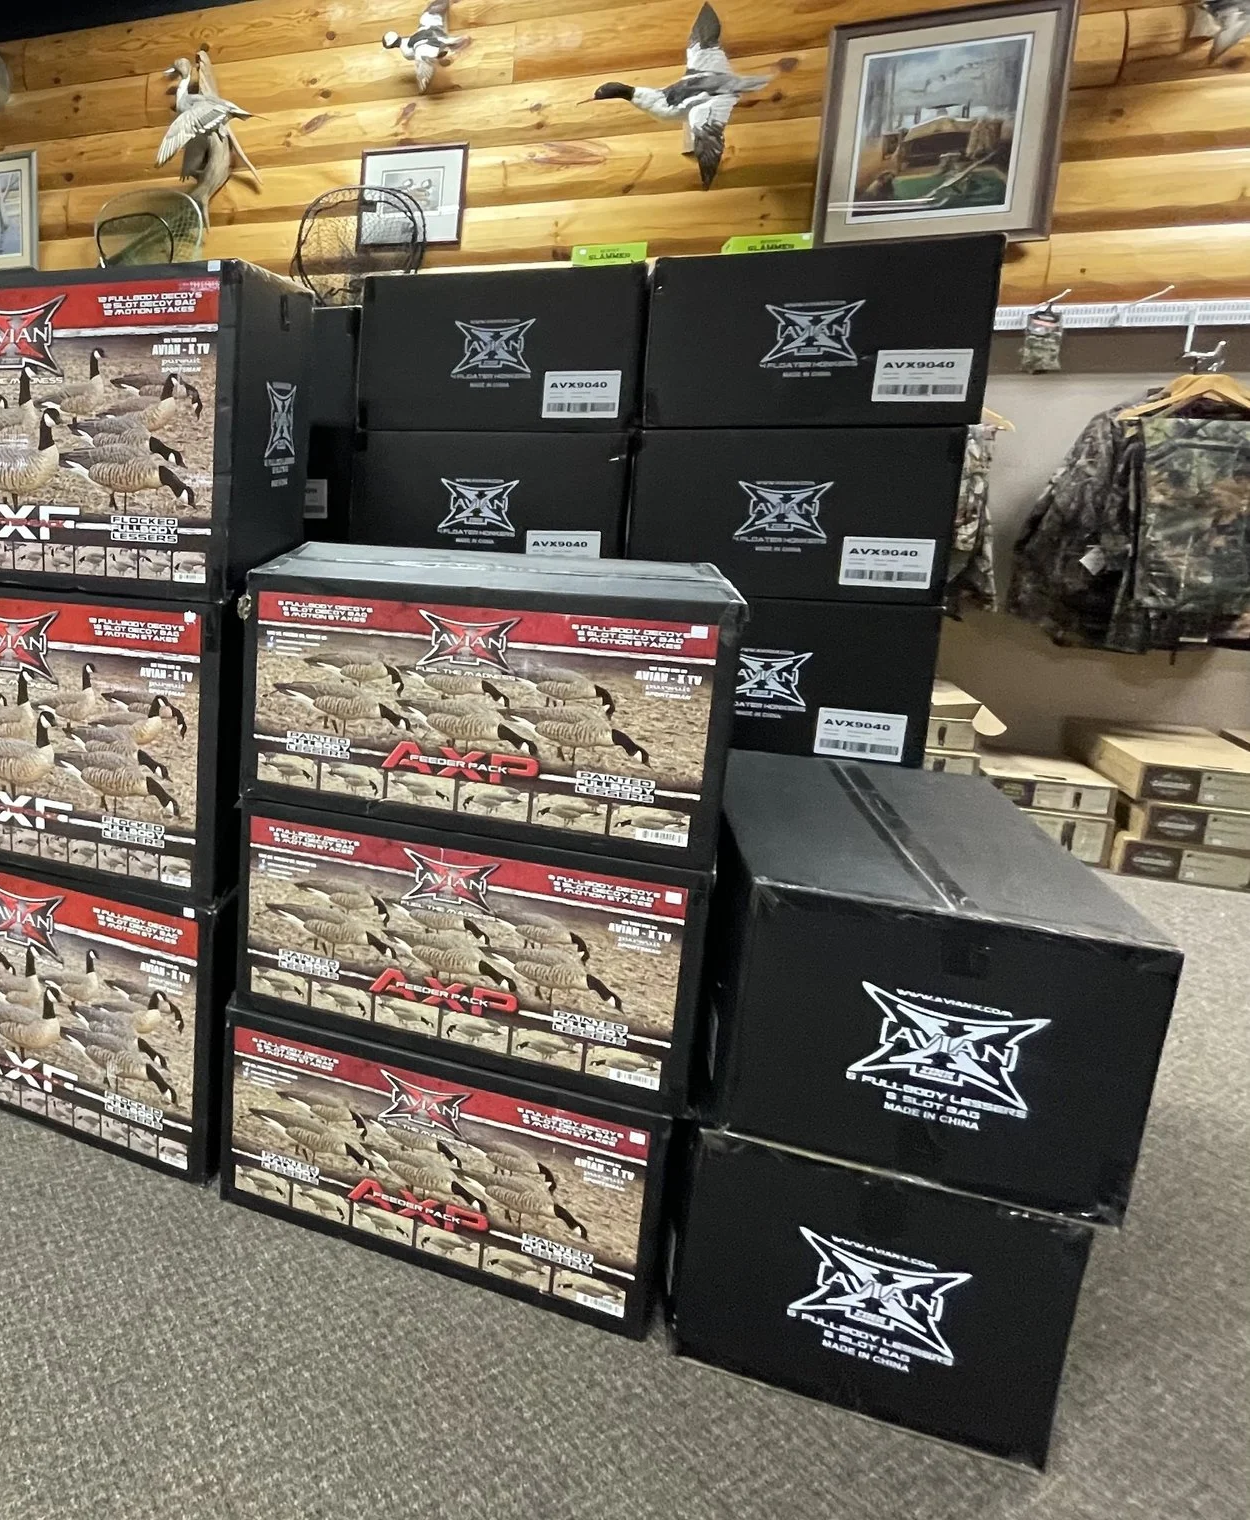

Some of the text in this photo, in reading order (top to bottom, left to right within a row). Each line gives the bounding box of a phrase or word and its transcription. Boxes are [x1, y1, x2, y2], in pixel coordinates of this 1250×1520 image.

[108, 294, 159, 302] FULLBODY
[782, 324, 847, 339] AVIAN
[152, 343, 210, 355] AVIAN TV
[469, 340, 521, 352] AVIAN
[883, 361, 955, 369] AVX9040
[453, 498, 506, 510] AVIAN
[755, 502, 816, 514] AVIAN
[112, 517, 176, 526] FLOCKED
[112, 525, 178, 534] FULLBODY
[112, 533, 177, 543] LESSERS
[849, 549, 918, 557] AVX9040
[285, 601, 373, 613] FULLBODY DECOYS
[98, 618, 185, 631] FULLBODY DECOYS
[128, 626, 158, 635] DECOY
[581, 625, 691, 638] FULLBODY DECOYS
[104, 631, 178, 643] MOTION STAKES
[436, 634, 502, 649] AVIAN
[588, 637, 682, 650] MOTION STAKES
[618, 633, 657, 641] DECOY
[140, 667, 166, 679] AVIAN
[181, 671, 193, 682] TV
[464, 671, 516, 681] MADNESS
[635, 670, 668, 682] AVIAN
[688, 676, 702, 686] TV
[737, 669, 796, 682] AVIAN
[824, 719, 891, 731] AVX9040
[290, 732, 347, 744] PAINTED
[382, 741, 539, 783] AXP
[409, 755, 508, 774] FEEDER PACK
[576, 779, 654, 794] FULLBODY
[580, 772, 652, 786] PAINTED
[576, 786, 653, 803] LESSERS
[103, 816, 164, 832] FLOCKED
[421, 872, 483, 890] AVIAN
[557, 876, 661, 898] FULLBODY DECOYS
[564, 888, 606, 899] MOTION
[592, 887, 630, 898] DECOY
[608, 922, 640, 936] AVIAN
[658, 932, 671, 943] TV
[369, 968, 518, 1016] AXP
[396, 981, 488, 1007] FEEDER PACK
[557, 1011, 625, 1031] PAINTED
[887, 1026, 1013, 1066] AVIAN
[861, 1074, 948, 1100] FULLBODY
[950, 1095, 1028, 1119] LESSERS
[397, 1094, 455, 1117] AVIAN
[902, 1095, 944, 1110] SLOT
[946, 1106, 980, 1120] BAG
[883, 1102, 980, 1131] MADE IN CHINA
[403, 1124, 420, 1133] THE
[574, 1157, 604, 1172] AVIAN
[621, 1170, 635, 1181] TV
[348, 1178, 489, 1231] AXP
[373, 1191, 461, 1224] FEEDER PACK
[824, 1271, 938, 1315] AVIAN
[801, 1312, 880, 1343] FULLBODY
[822, 1339, 910, 1372] MADE IN CHINA
[839, 1334, 878, 1352] SLOT
[878, 1348, 910, 1363] BAG
